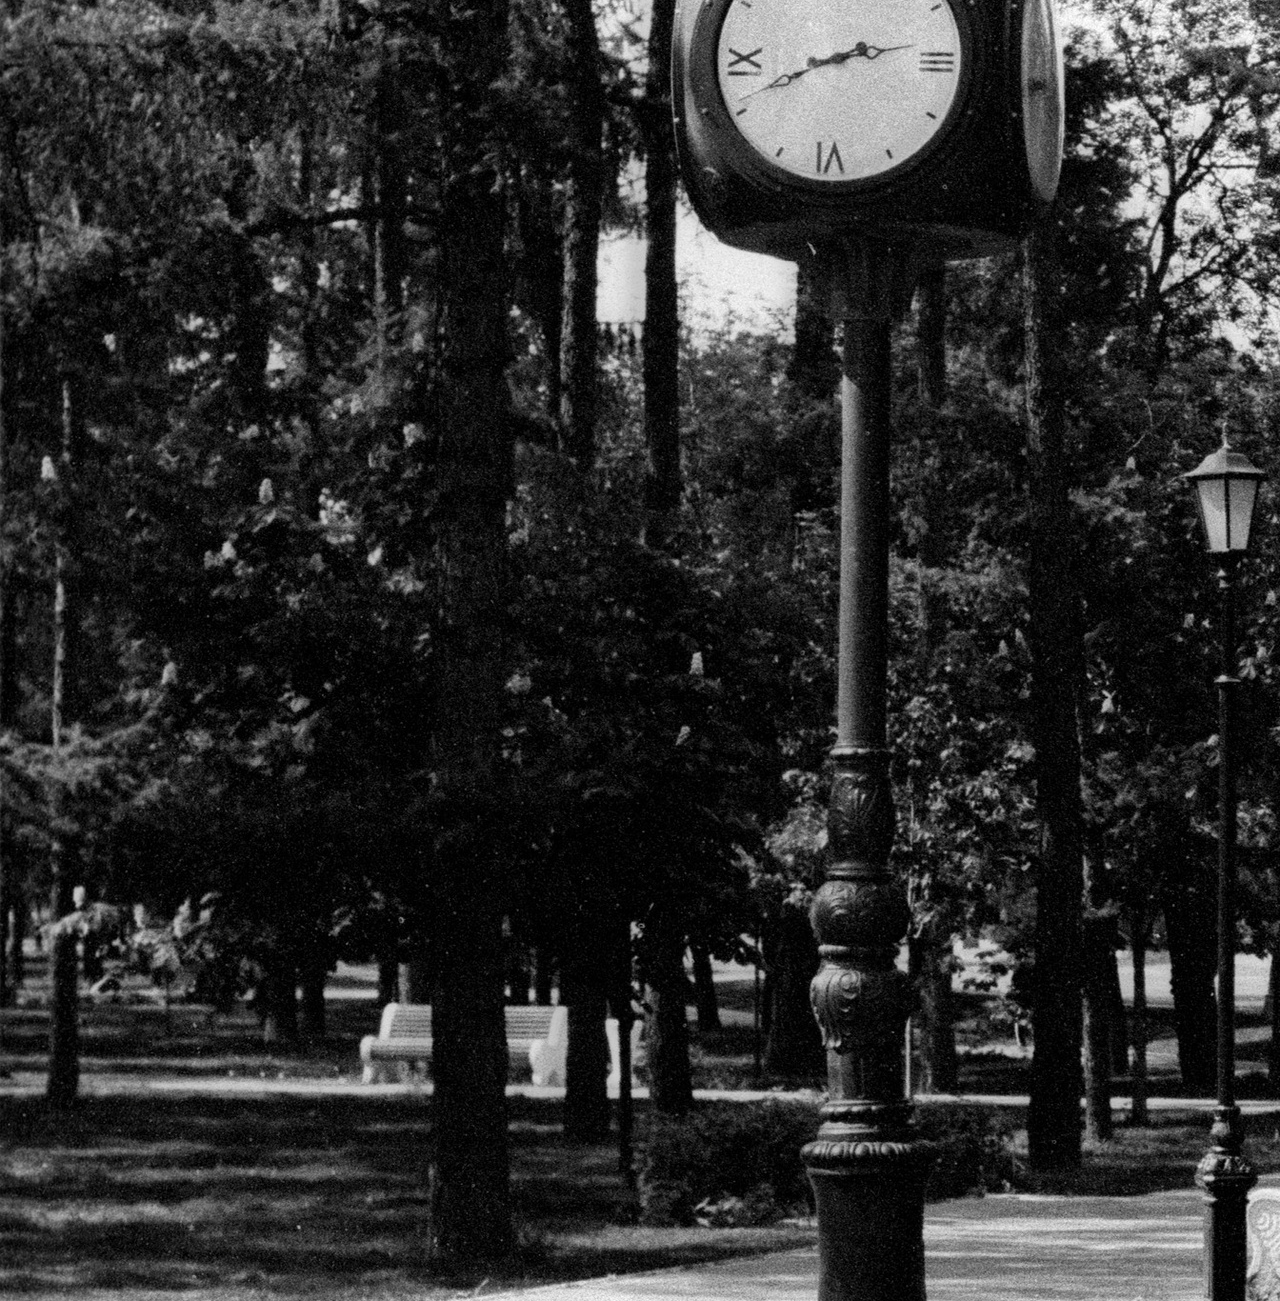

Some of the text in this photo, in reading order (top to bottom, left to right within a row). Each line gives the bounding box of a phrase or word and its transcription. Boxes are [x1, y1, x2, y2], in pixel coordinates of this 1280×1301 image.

[727, 47, 763, 77] IX
[919, 51, 955, 73] III
[816, 141, 845, 175] VI
